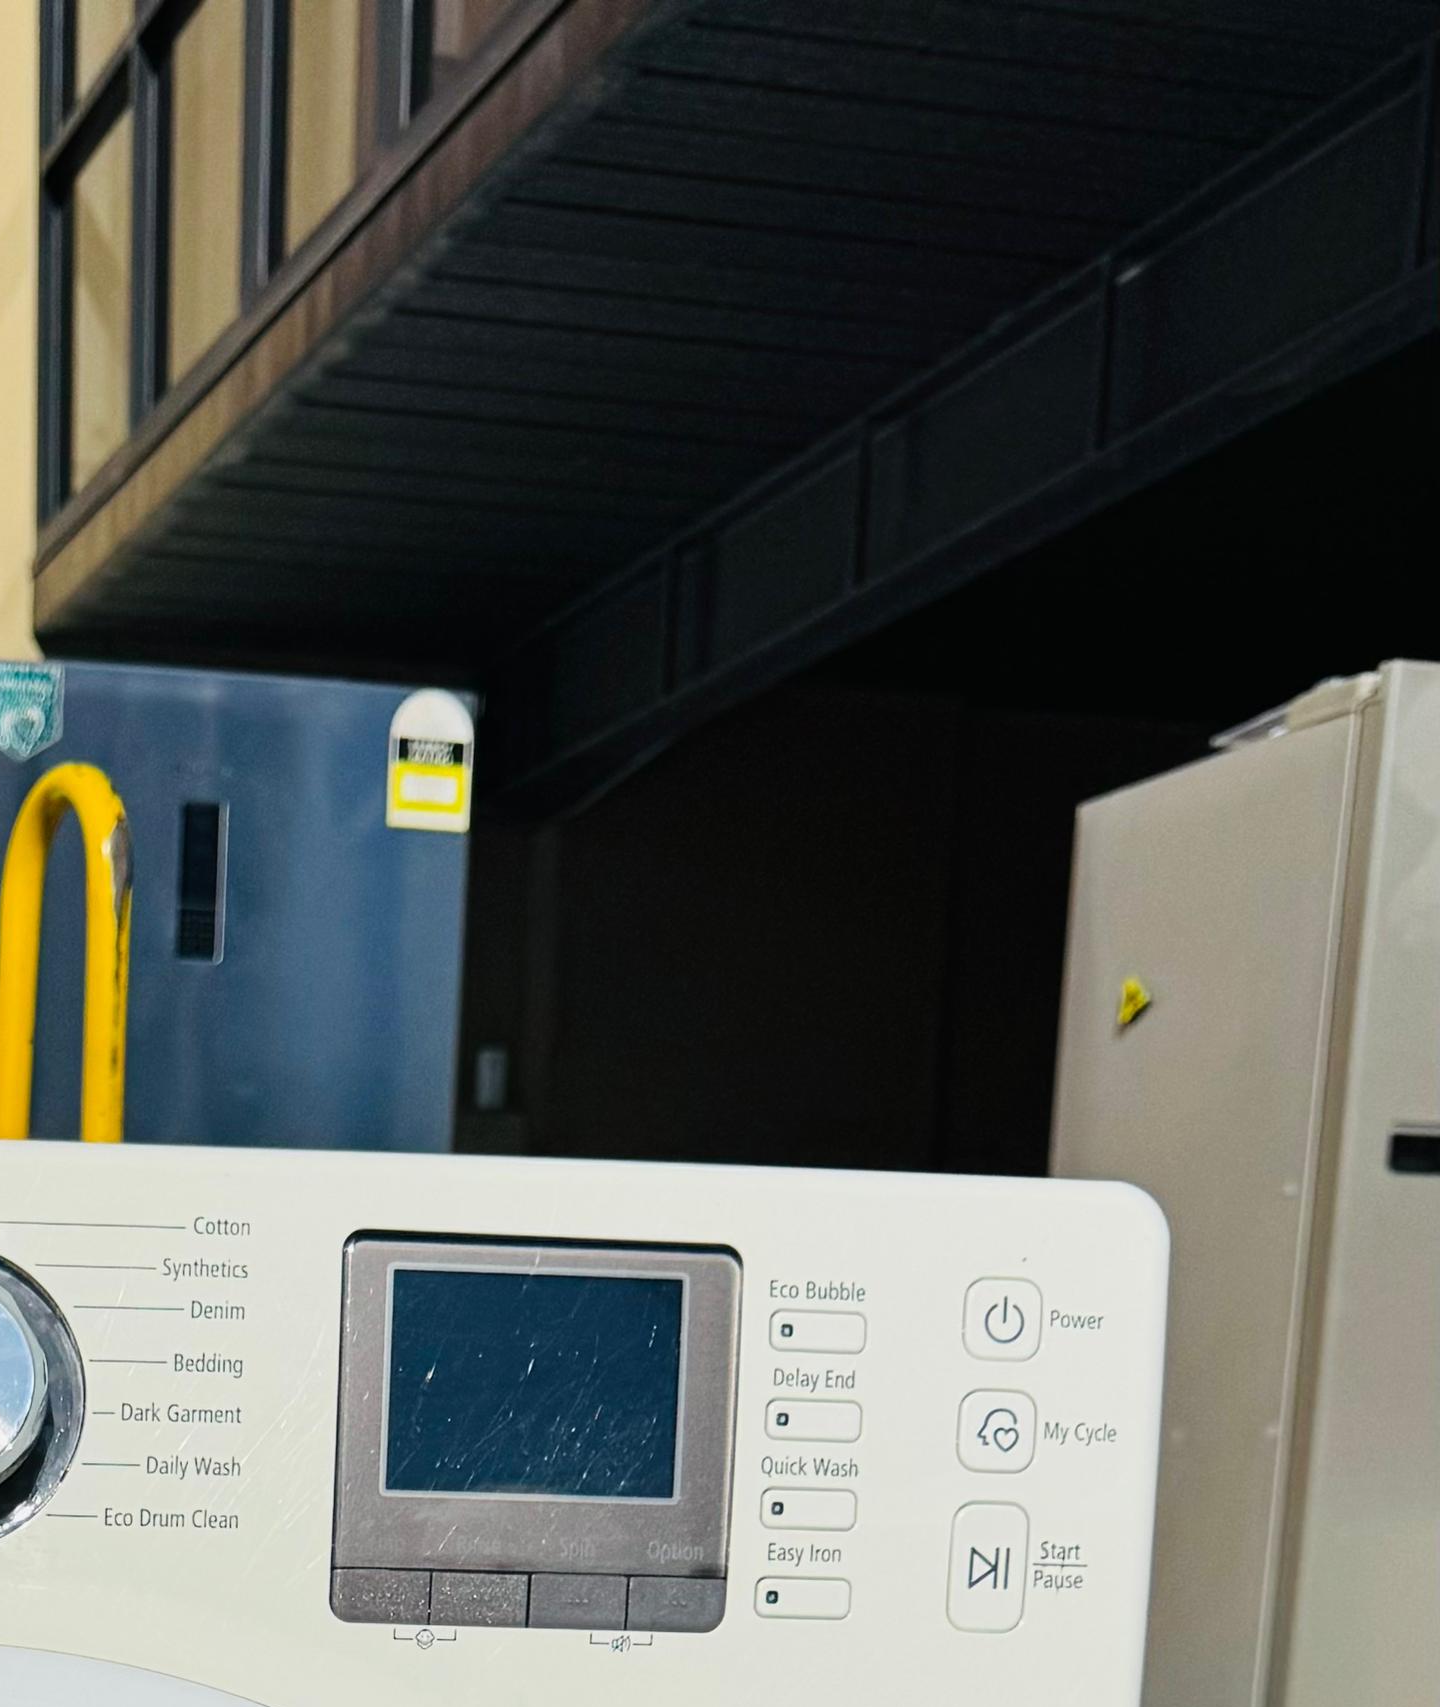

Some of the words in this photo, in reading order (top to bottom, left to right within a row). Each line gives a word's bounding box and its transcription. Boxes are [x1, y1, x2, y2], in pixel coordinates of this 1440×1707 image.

[193, 1216, 251, 1236] Cotton
[162, 1257, 249, 1281] Synthetics
[769, 1280, 799, 1299] Eco
[805, 1281, 866, 1302] Bubble
[191, 1300, 245, 1320] Denim
[1049, 1310, 1104, 1330] Power
[174, 1353, 243, 1378] Bedding
[773, 1368, 819, 1393] Delay
[825, 1370, 856, 1390] End
[121, 1402, 161, 1422] Dark
[167, 1403, 242, 1424] Garment
[1043, 1421, 1068, 1445] My
[1074, 1422, 1117, 1445] Cycle
[146, 1455, 188, 1480] Daily
[194, 1456, 241, 1476] Wash
[760, 1456, 807, 1477] Quick
[813, 1458, 859, 1478] Wash
[104, 1508, 133, 1527] Eco
[140, 1508, 185, 1528] Drum
[192, 1509, 239, 1529] Clean
[647, 1540, 704, 1564] Option
[767, 1543, 804, 1566] Easy
[809, 1543, 842, 1563] Iron
[1040, 1541, 1081, 1561] Start
[1033, 1570, 1084, 1591] Pause
